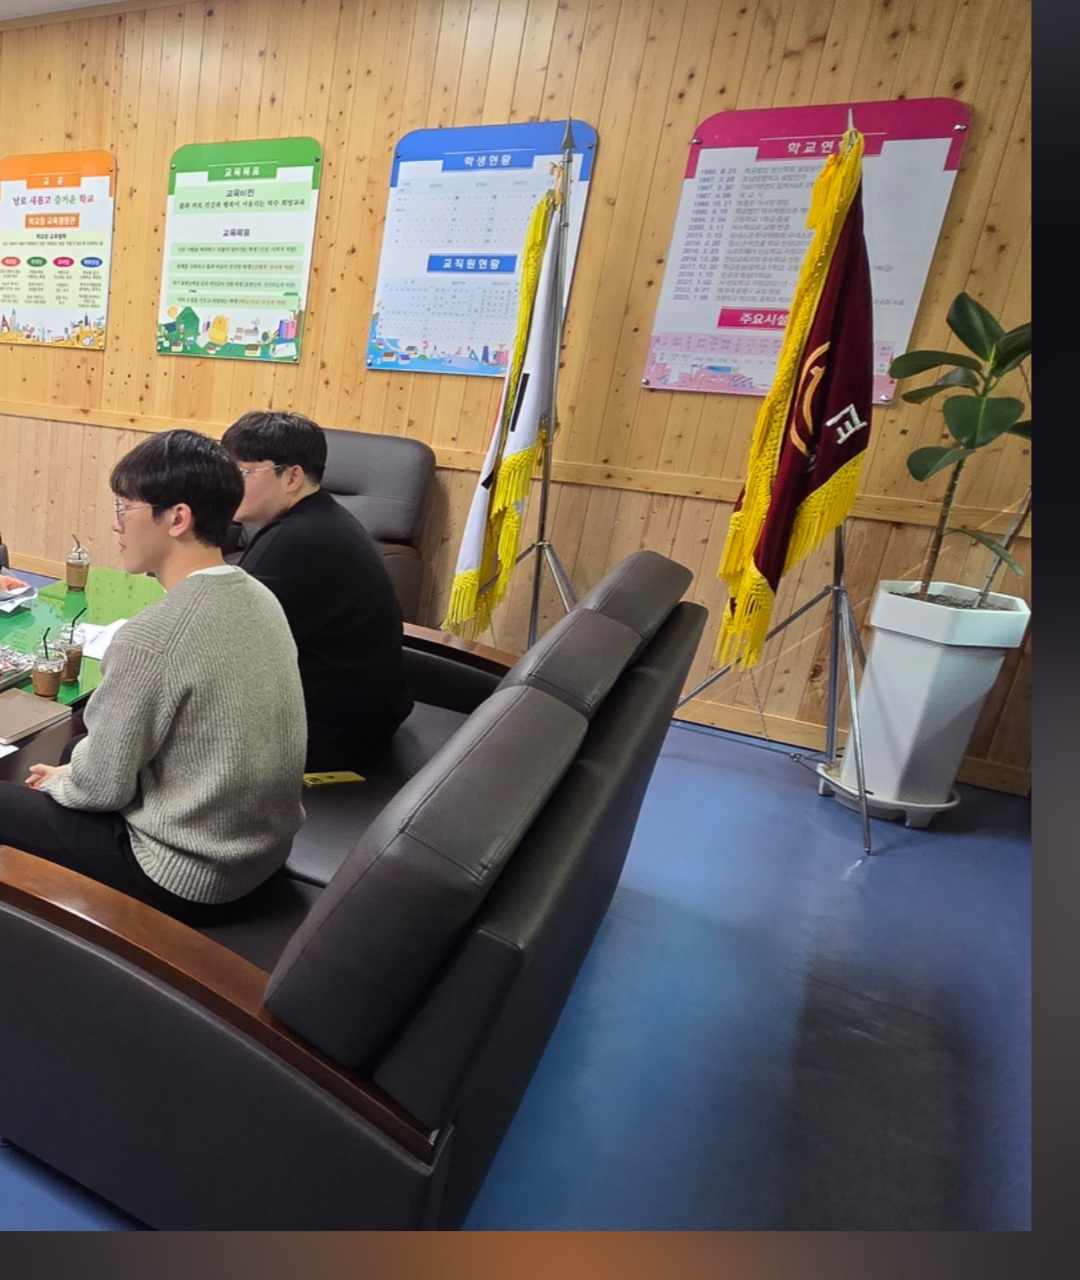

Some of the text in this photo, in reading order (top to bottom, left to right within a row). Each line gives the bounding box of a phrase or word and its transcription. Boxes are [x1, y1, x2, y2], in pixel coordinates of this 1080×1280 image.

[464, 155, 512, 166] 학생현황
[224, 167, 260, 177] 교육목표
[226, 189, 255, 198] 교육비전
[79, 194, 95, 204] 학교
[222, 228, 250, 237] 교육목표
[443, 259, 500, 270] 교직원현황
